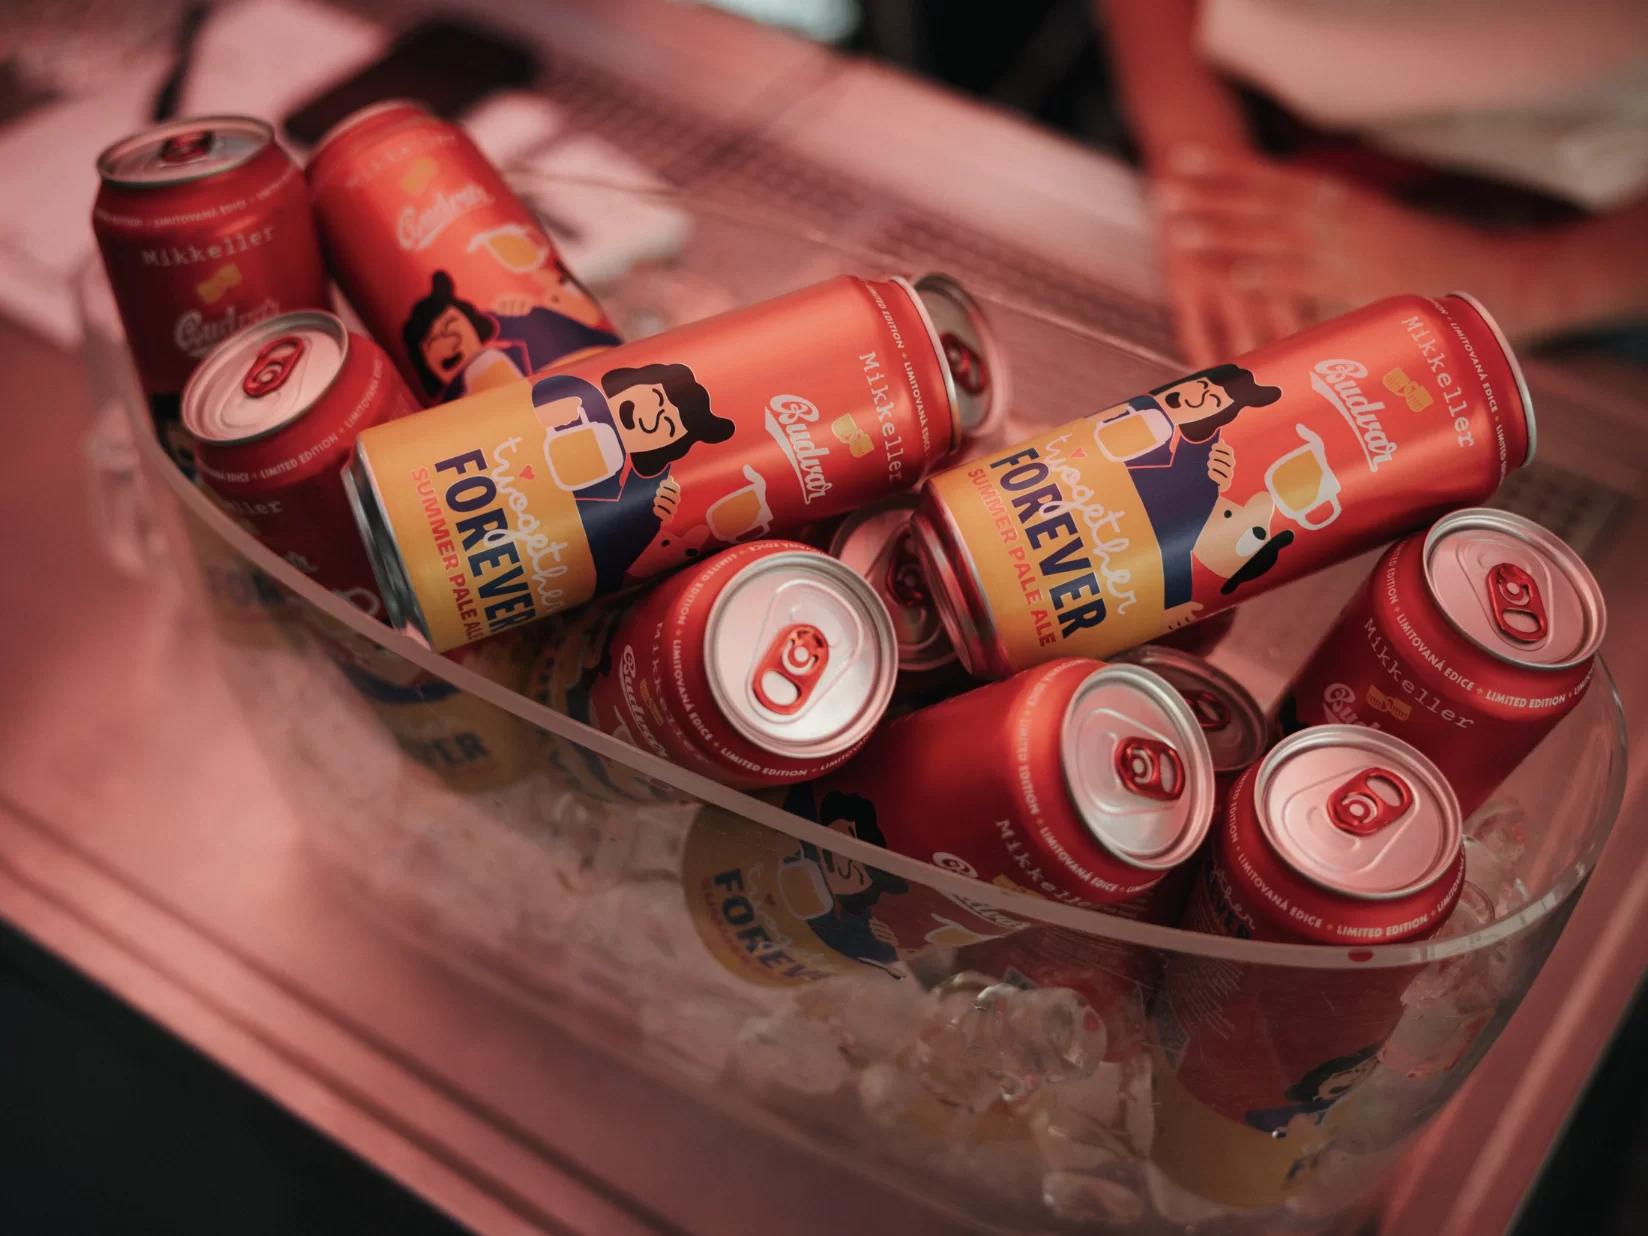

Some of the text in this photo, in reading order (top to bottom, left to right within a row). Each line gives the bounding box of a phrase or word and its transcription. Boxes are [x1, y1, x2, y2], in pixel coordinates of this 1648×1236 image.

[141, 226, 275, 268] Mikkeller
[858, 351, 905, 482] Mikkeller
[882, 310, 906, 350] EDITION
[903, 361, 931, 429] LIMITOVANÁ
[1401, 316, 1475, 448] Mikkeller
[1450, 321, 1489, 382] LIMITOVANÁ
[1482, 382, 1499, 414] EDICE
[260, 458, 299, 479] LIMITED
[299, 434, 339, 464] EDITION
[411, 466, 462, 571] SUMMER
[448, 573, 479, 621] PALE
[433, 448, 537, 634] FOREVER
[702, 553, 739, 583] LIMITED
[967, 468, 1057, 648] SUMMER PALE ALE
[989, 447, 1107, 640] FOREVER
[678, 582, 705, 626] EDITION
[1386, 566, 1399, 606] EDITION
[1396, 612, 1444, 672] LIMITOVANÁ
[1443, 667, 1475, 692] EDICE
[1485, 689, 1528, 709] LIMITED
[1528, 693, 1567, 710] EDITION
[672, 639, 694, 713] LIMITOVANÁ
[688, 709, 713, 742] EDICE
[1364, 617, 1475, 729] Mikkeller
[720, 746, 761, 772] LIMITED
[762, 765, 808, 777] EDITION
[1018, 763, 1042, 815] EDITION
[1038, 826, 1092, 882] LIMITOVANÁ
[1090, 873, 1120, 894] EDICE
[1227, 801, 1239, 844] EDITION
[1236, 854, 1289, 911] LIMITOVANÁ
[1289, 907, 1323, 929] EDICE
[1336, 924, 1383, 938] LIMITED
[1385, 914, 1429, 937] EDITION
